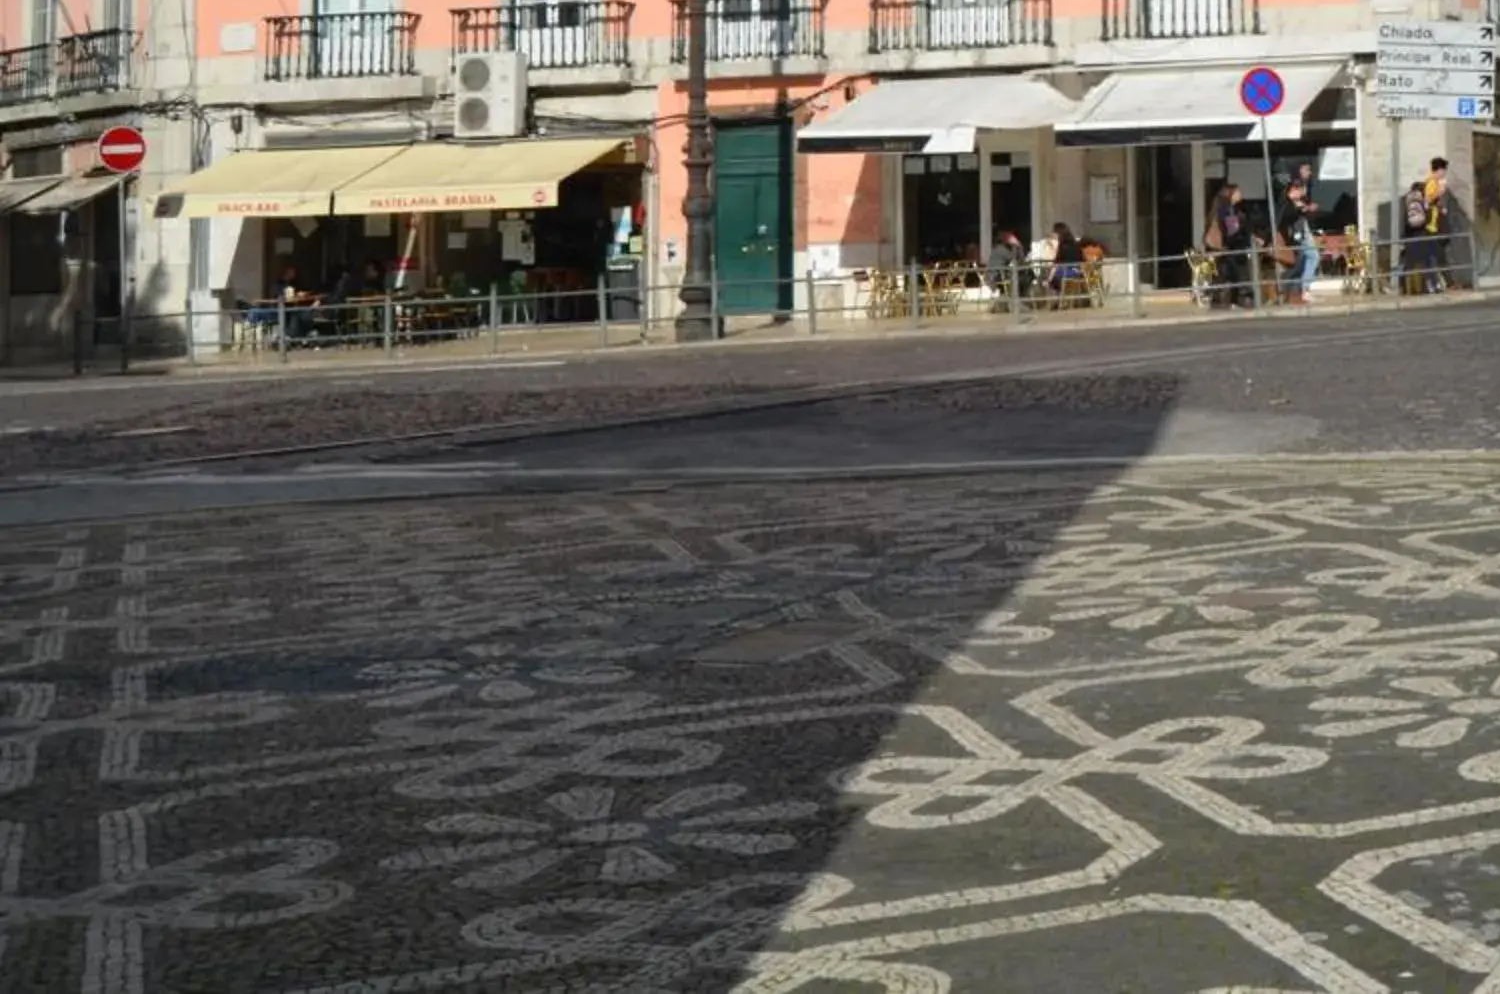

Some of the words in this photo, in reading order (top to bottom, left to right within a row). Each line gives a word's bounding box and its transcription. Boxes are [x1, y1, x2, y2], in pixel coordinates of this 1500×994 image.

[1379, 24, 1433, 39] Chiado
[1442, 49, 1472, 64] Real
[1377, 73, 1414, 87] Rato
[369, 196, 438, 208] PASTELARIA
